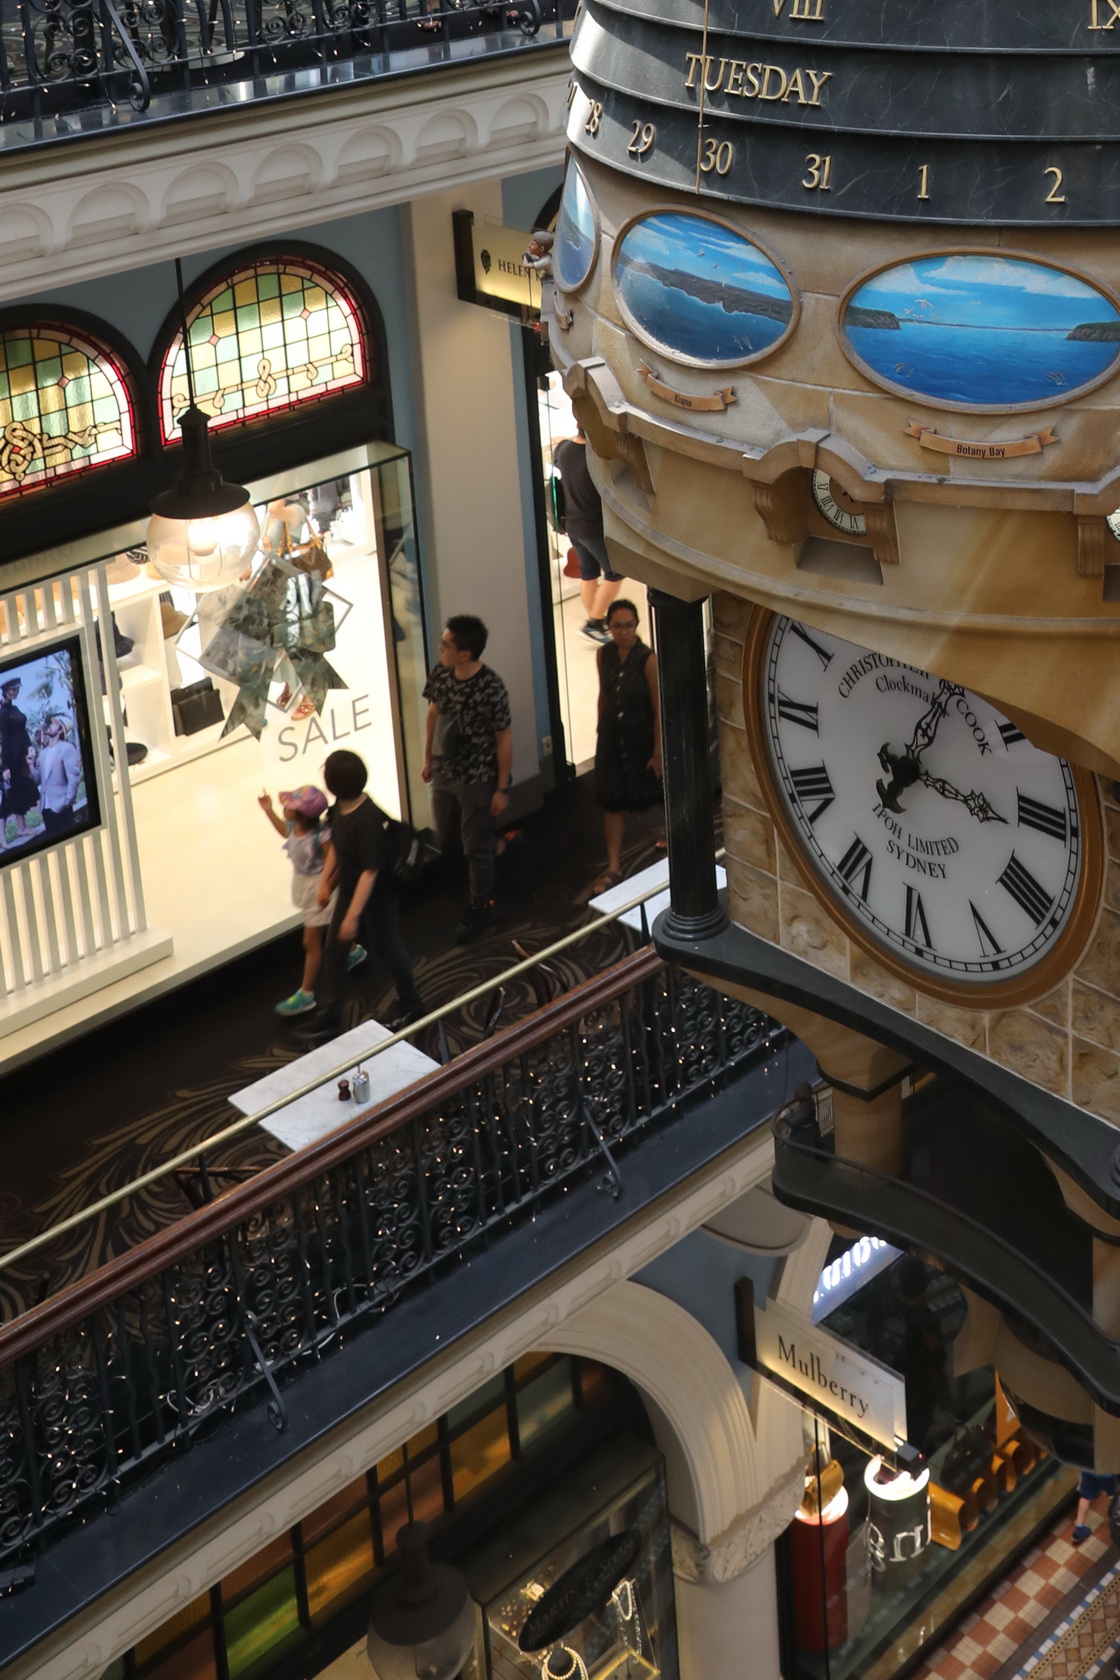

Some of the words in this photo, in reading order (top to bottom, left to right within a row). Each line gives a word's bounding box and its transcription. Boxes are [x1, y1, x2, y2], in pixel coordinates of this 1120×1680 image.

[684, 52, 833, 107] TUESDAY
[585, 98, 602, 134] 28
[627, 119, 656, 154] 29
[700, 138, 734, 175] 30
[803, 154, 832, 191] 31
[917, 164, 930, 200] 1
[1044, 167, 1066, 203] 2
[498, 259, 531, 279] HELEN
[957, 444, 986, 458] Botany
[989, 447, 1006, 458] Bay
[838, 652, 929, 699] CHRISTO
[956, 699, 993, 756] COOK
[875, 674, 936, 707] Clockma
[278, 693, 372, 762] SALE
[872, 803, 902, 839] IPOH
[907, 833, 960, 857] LIMITED
[1016, 786, 1067, 848] III
[886, 839, 947, 879] SYDNEY
[778, 1334, 870, 1419] Mulberry
